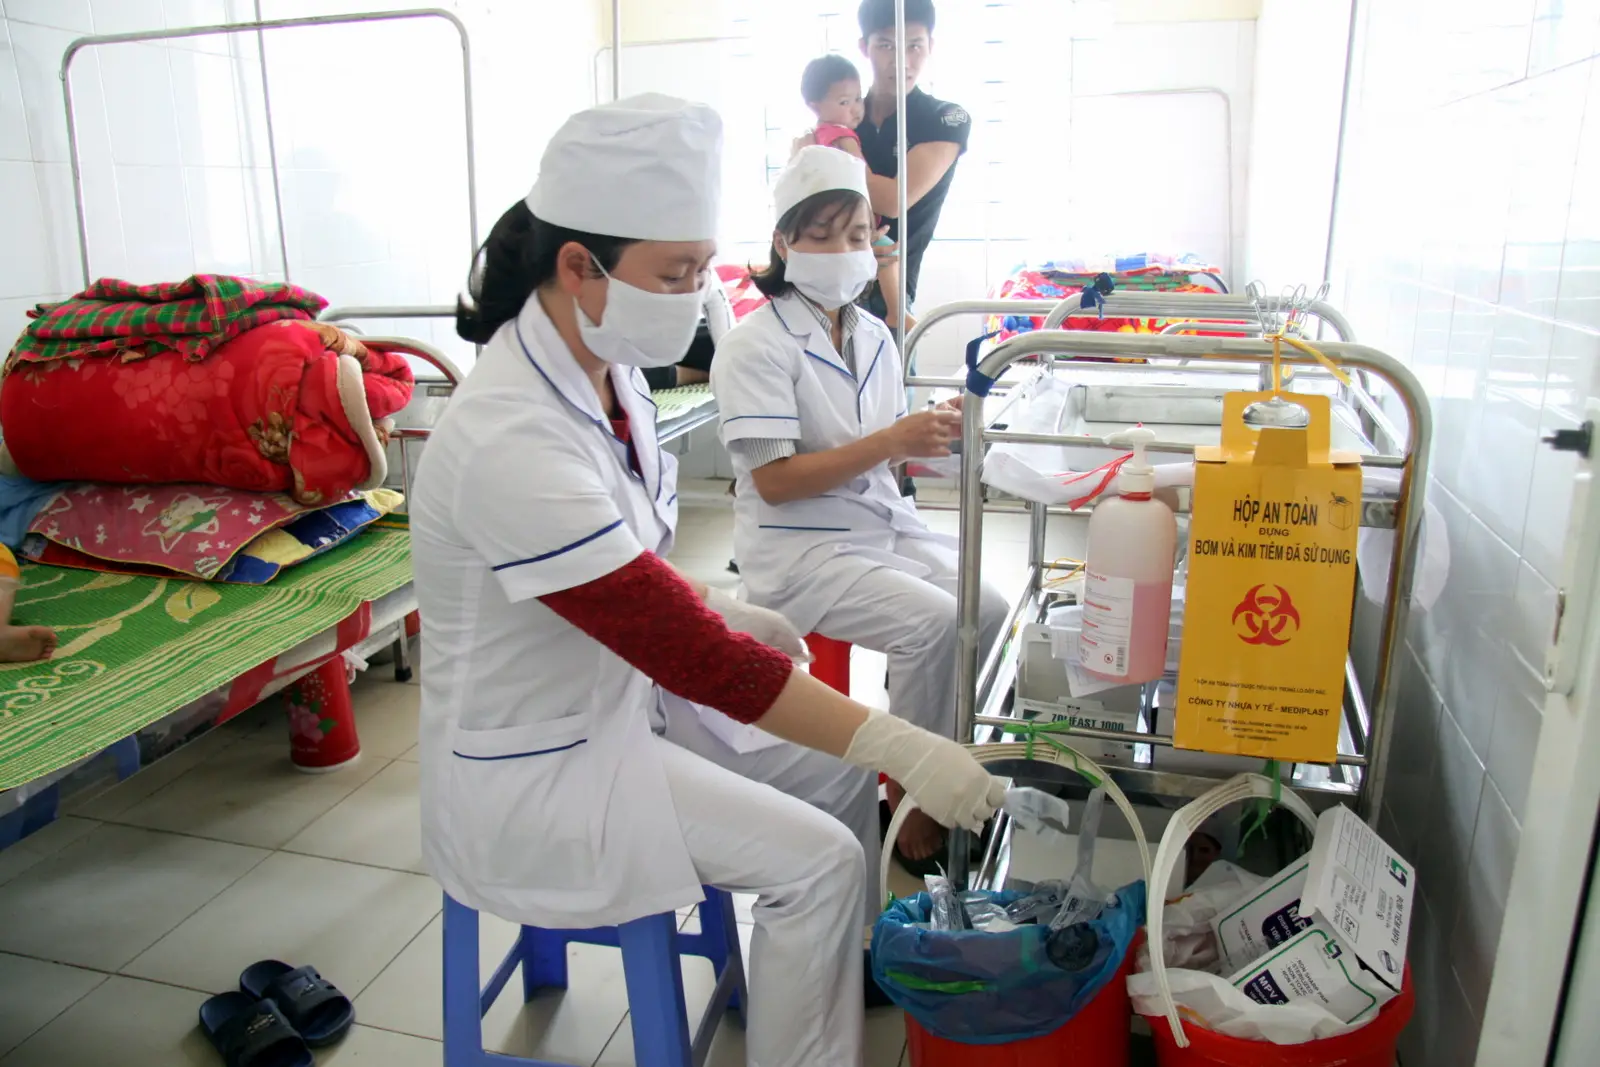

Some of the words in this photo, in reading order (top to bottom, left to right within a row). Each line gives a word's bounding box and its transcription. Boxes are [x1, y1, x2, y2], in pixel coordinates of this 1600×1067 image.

[1233, 494, 1260, 528] HỘP
[1262, 501, 1281, 524] AN
[1284, 496, 1318, 526] TOÀN
[1195, 539, 1219, 556] BƠM
[1221, 537, 1236, 557] VÀ
[1237, 543, 1257, 559] KIM
[1259, 541, 1283, 561] TIÊM
[1286, 543, 1301, 562] ĐÃ
[1303, 542, 1319, 563] SỬ
[1320, 547, 1350, 567] DỤNG
[1188, 696, 1213, 706] CÔNG
[1280, 706, 1330, 716] MEDIPLAST
[1101, 721, 1125, 732] 1000
[1258, 976, 1278, 998] MPV
